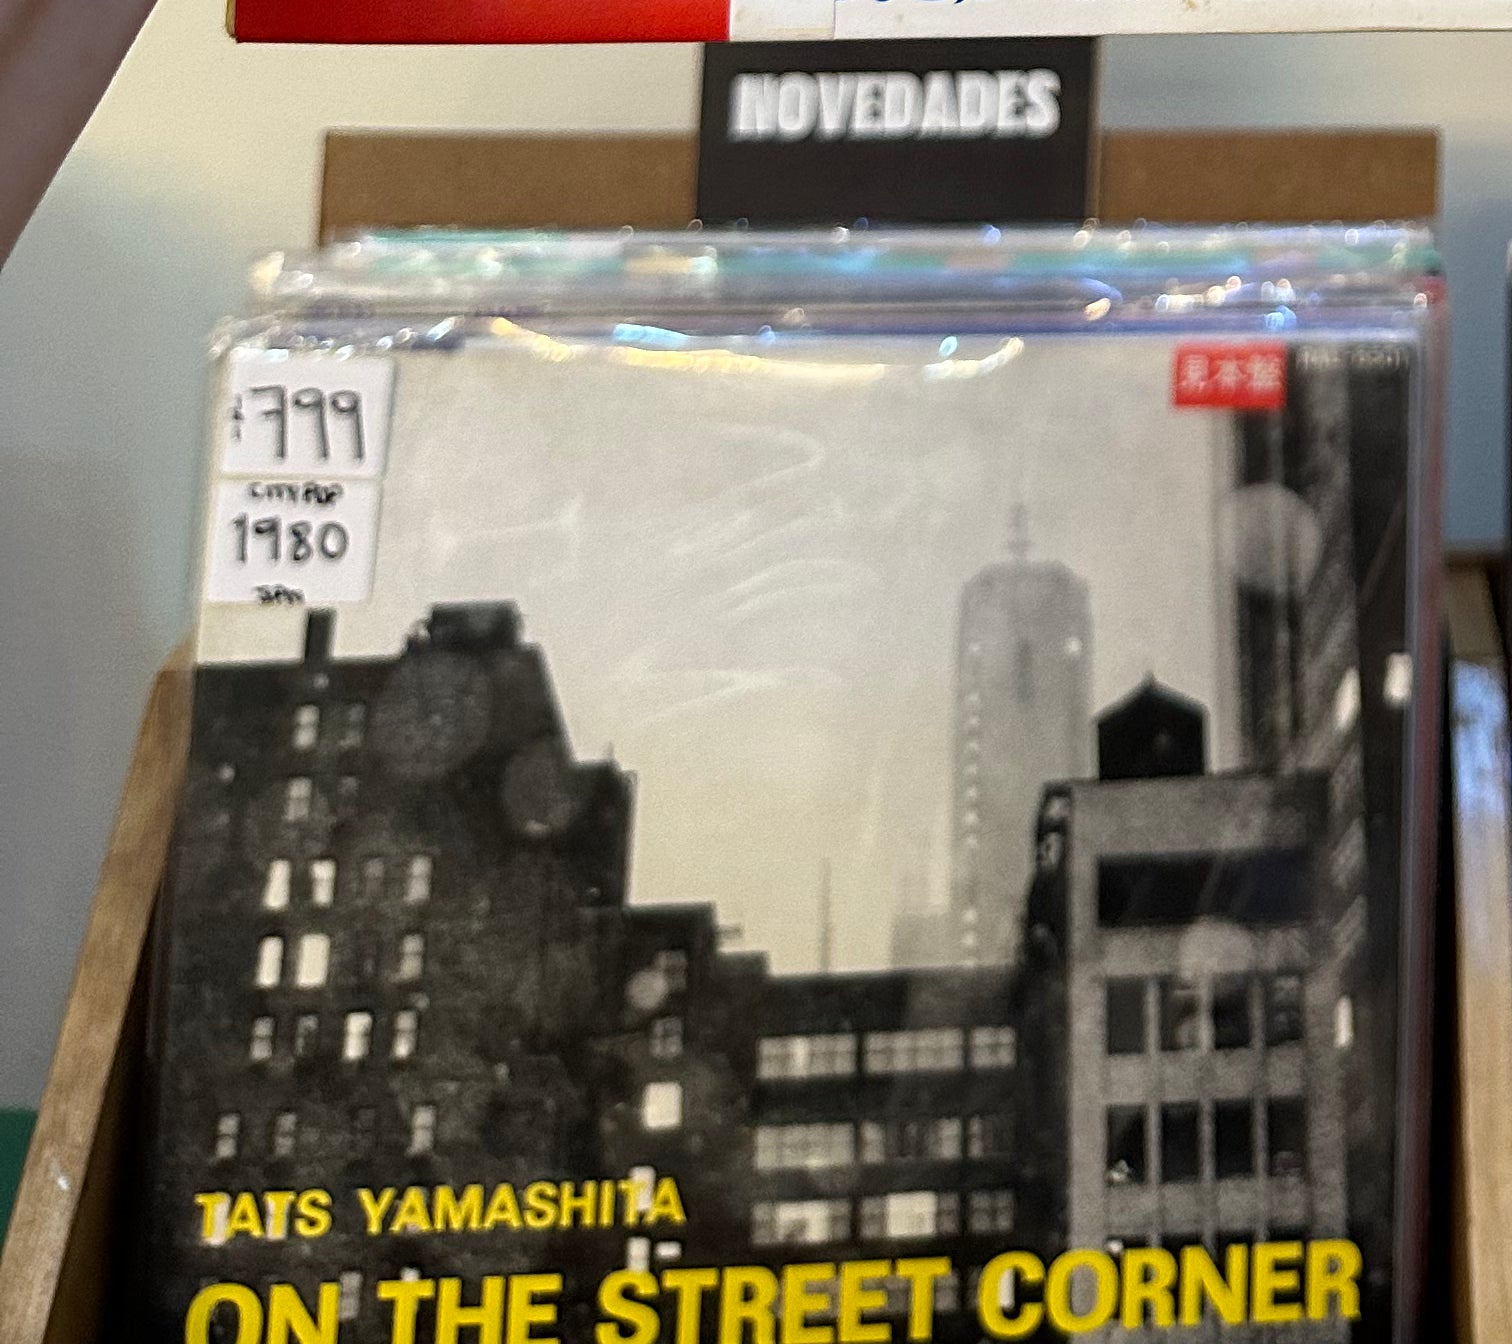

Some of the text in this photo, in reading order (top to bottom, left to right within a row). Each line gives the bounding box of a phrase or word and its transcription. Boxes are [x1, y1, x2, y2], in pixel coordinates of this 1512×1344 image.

[730, 68, 1062, 142] NOVEDADES
[232, 512, 348, 563] 1980
[195, 1176, 687, 1242] TATS YAMASHITA
[185, 1238, 1364, 1344] ON THE STREET CORNER
